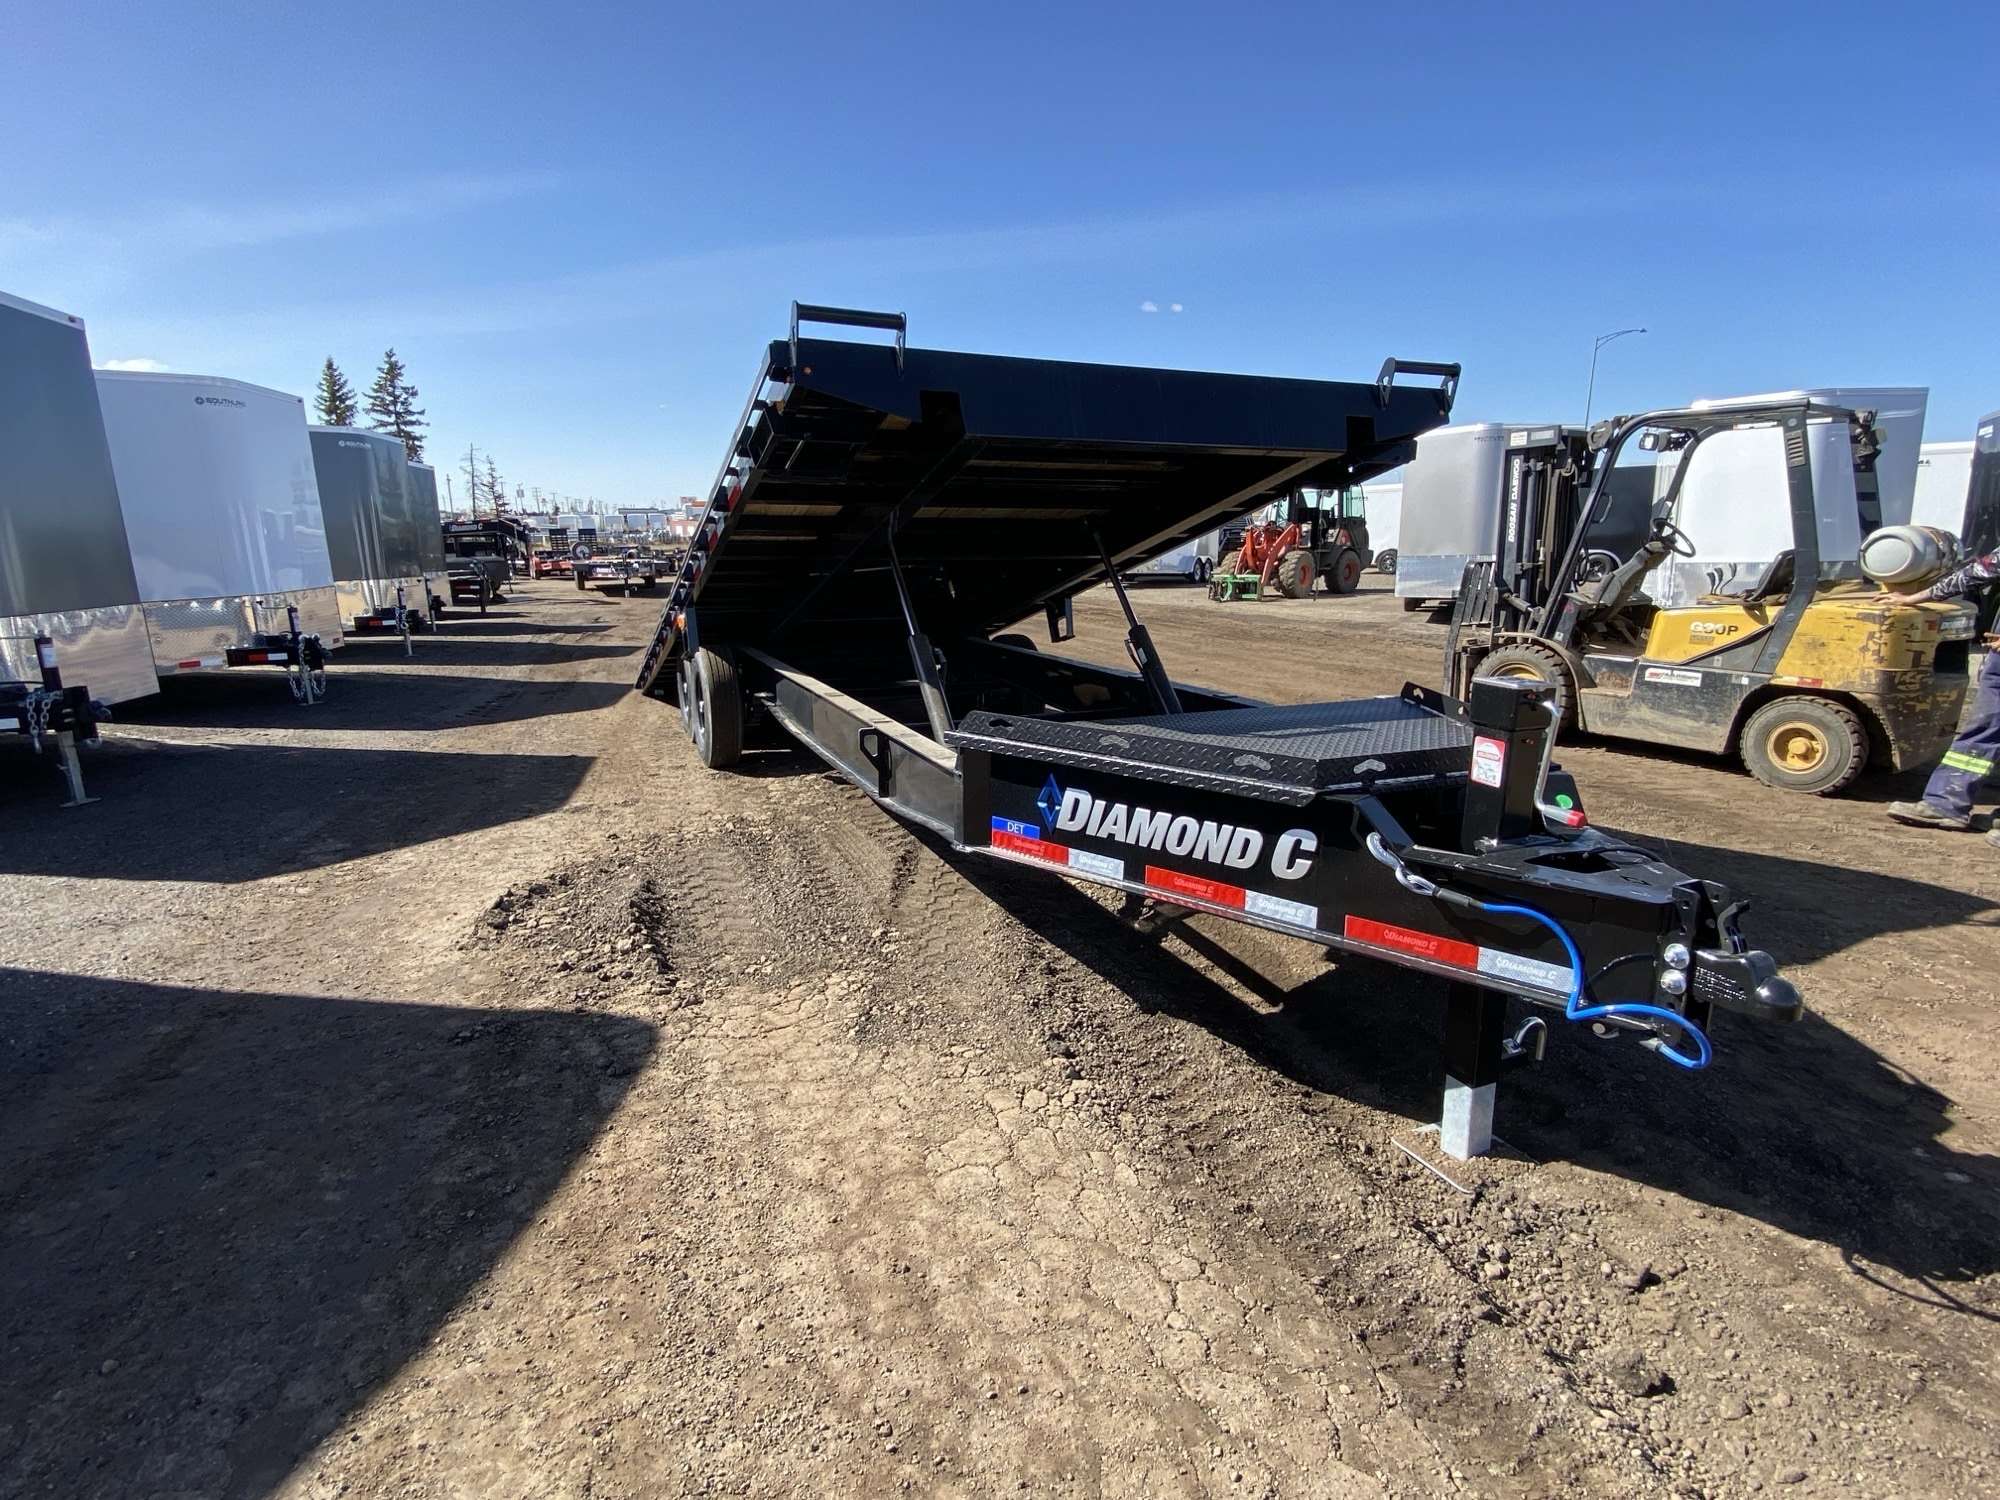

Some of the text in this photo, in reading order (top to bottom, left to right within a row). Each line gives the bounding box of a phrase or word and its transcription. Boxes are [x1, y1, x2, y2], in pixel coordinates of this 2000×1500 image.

[1508, 458, 1521, 542] DOOSAN DAEWOO
[1006, 820, 1025, 835] DET
[1055, 786, 1319, 880] DIAMOND C
[1389, 931, 1438, 950] DIAMOND C
[1547, 970, 1558, 980] C
